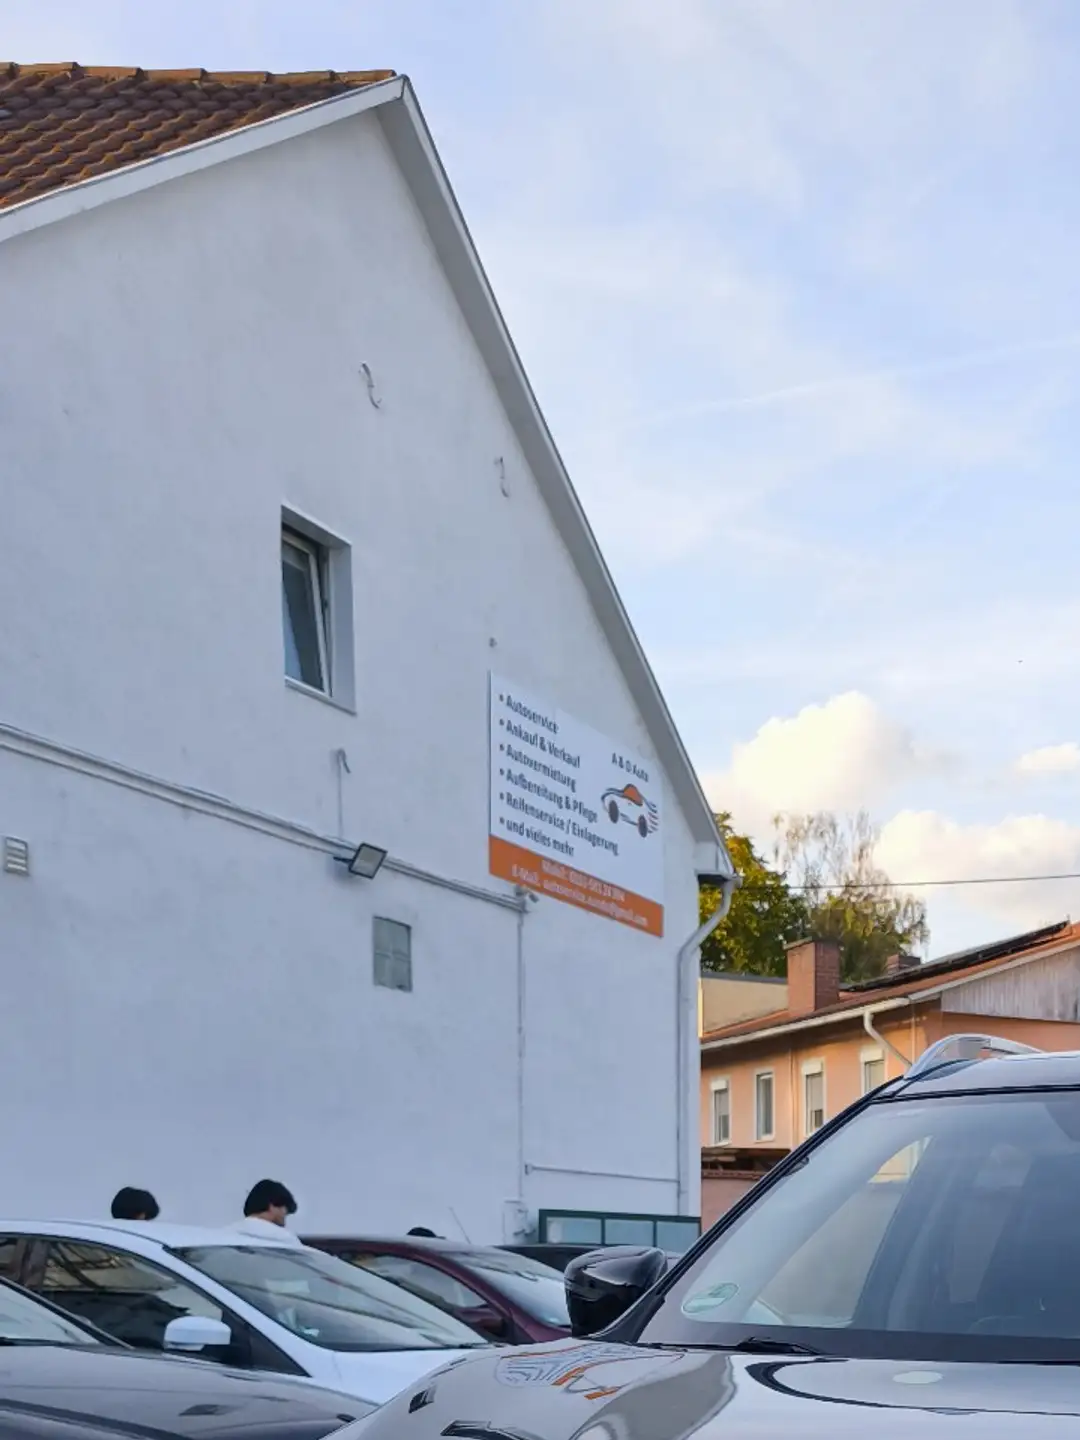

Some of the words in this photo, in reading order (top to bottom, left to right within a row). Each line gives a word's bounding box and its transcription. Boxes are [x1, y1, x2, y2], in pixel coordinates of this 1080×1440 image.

[506, 720, 538, 747] Ankauf
[539, 736, 547, 751] &
[548, 741, 580, 768] Verkauf
[506, 818, 524, 836] und
